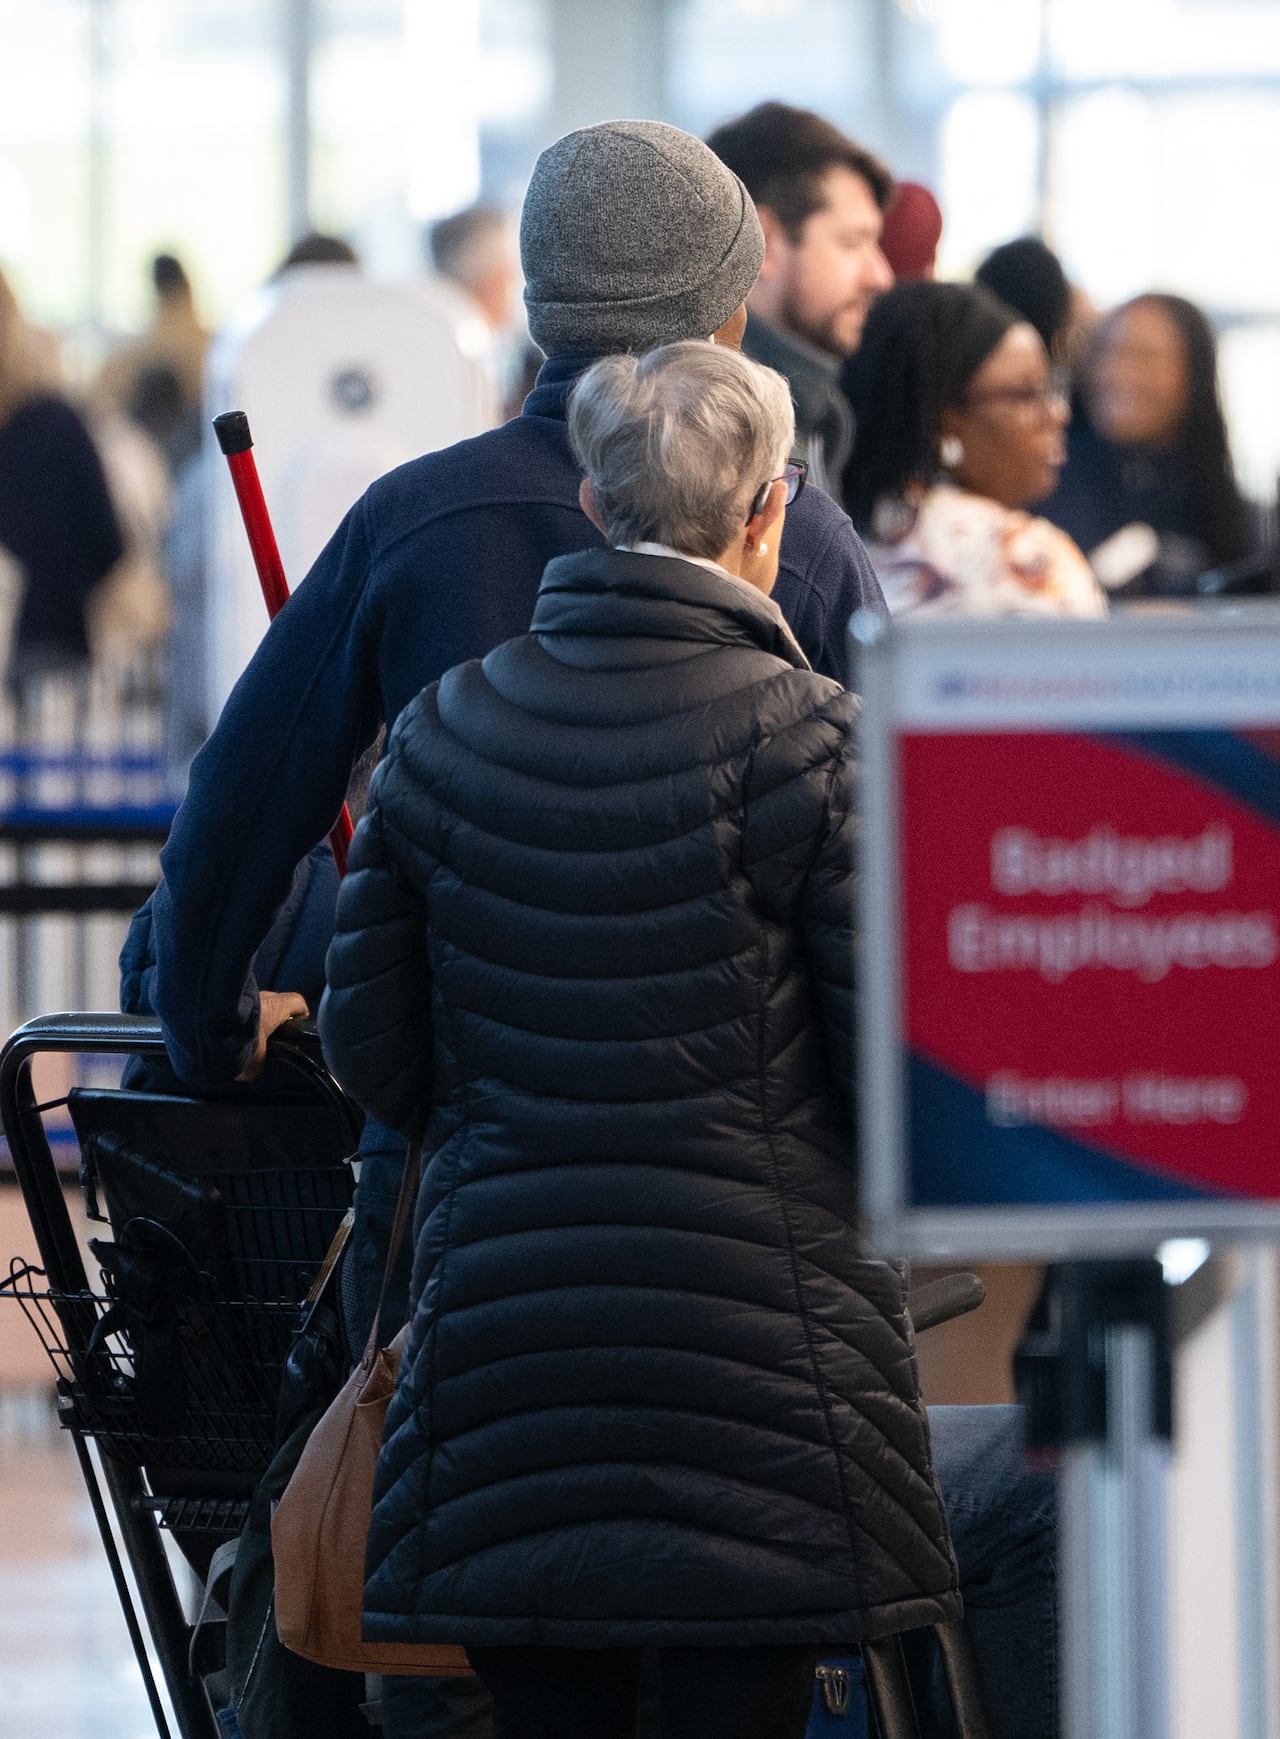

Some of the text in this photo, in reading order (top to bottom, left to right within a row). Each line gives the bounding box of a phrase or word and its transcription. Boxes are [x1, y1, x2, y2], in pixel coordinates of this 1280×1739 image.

[991, 825, 1233, 906] Badged
[948, 906, 1280, 982] Employees
[987, 1073, 1247, 1127] Enter Here
